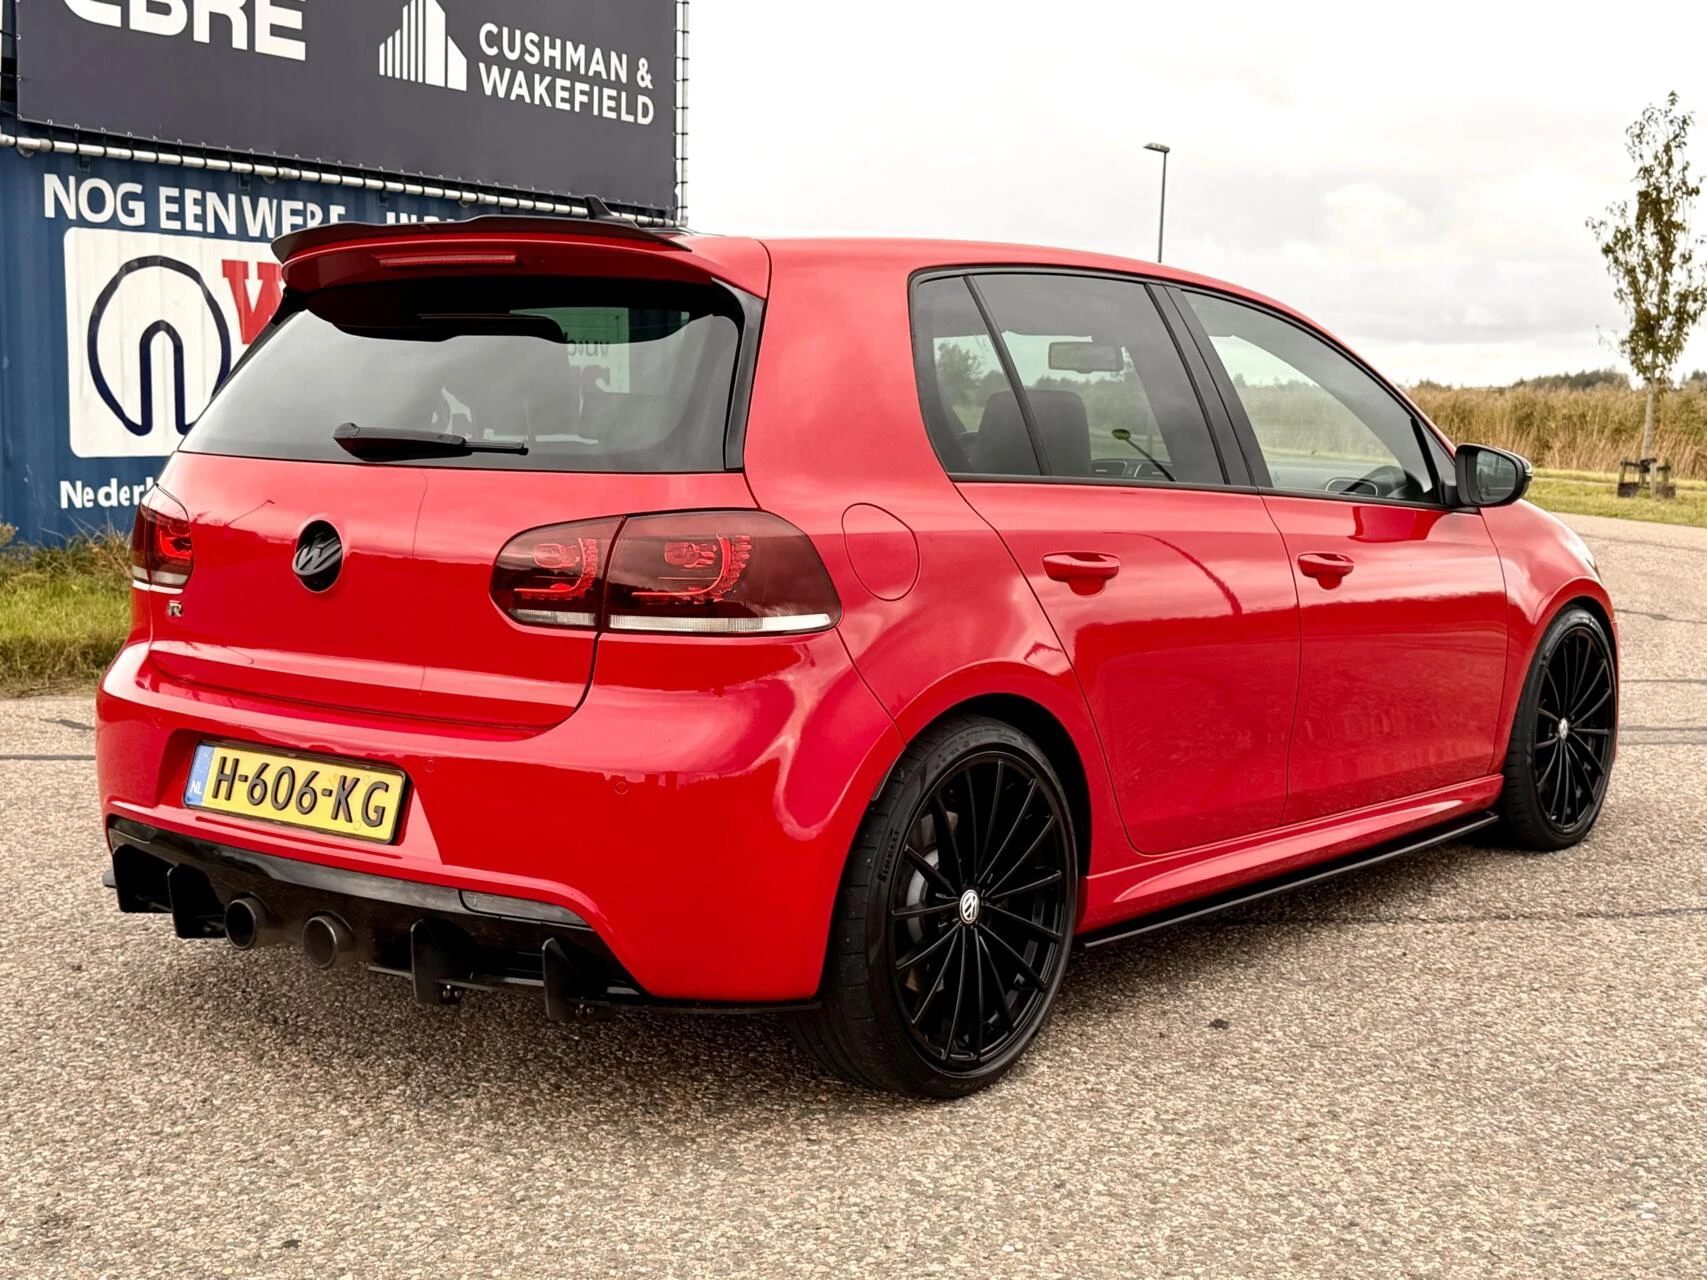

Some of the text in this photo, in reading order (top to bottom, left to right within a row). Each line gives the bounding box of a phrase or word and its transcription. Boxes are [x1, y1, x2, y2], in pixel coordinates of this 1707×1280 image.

[64, 0, 306, 62] RE
[479, 22, 654, 90] CUSHMAN &
[478, 62, 655, 126] WAKEFIELD
[43, 173, 146, 227] NOG
[211, 756, 390, 828] H-606-KG
